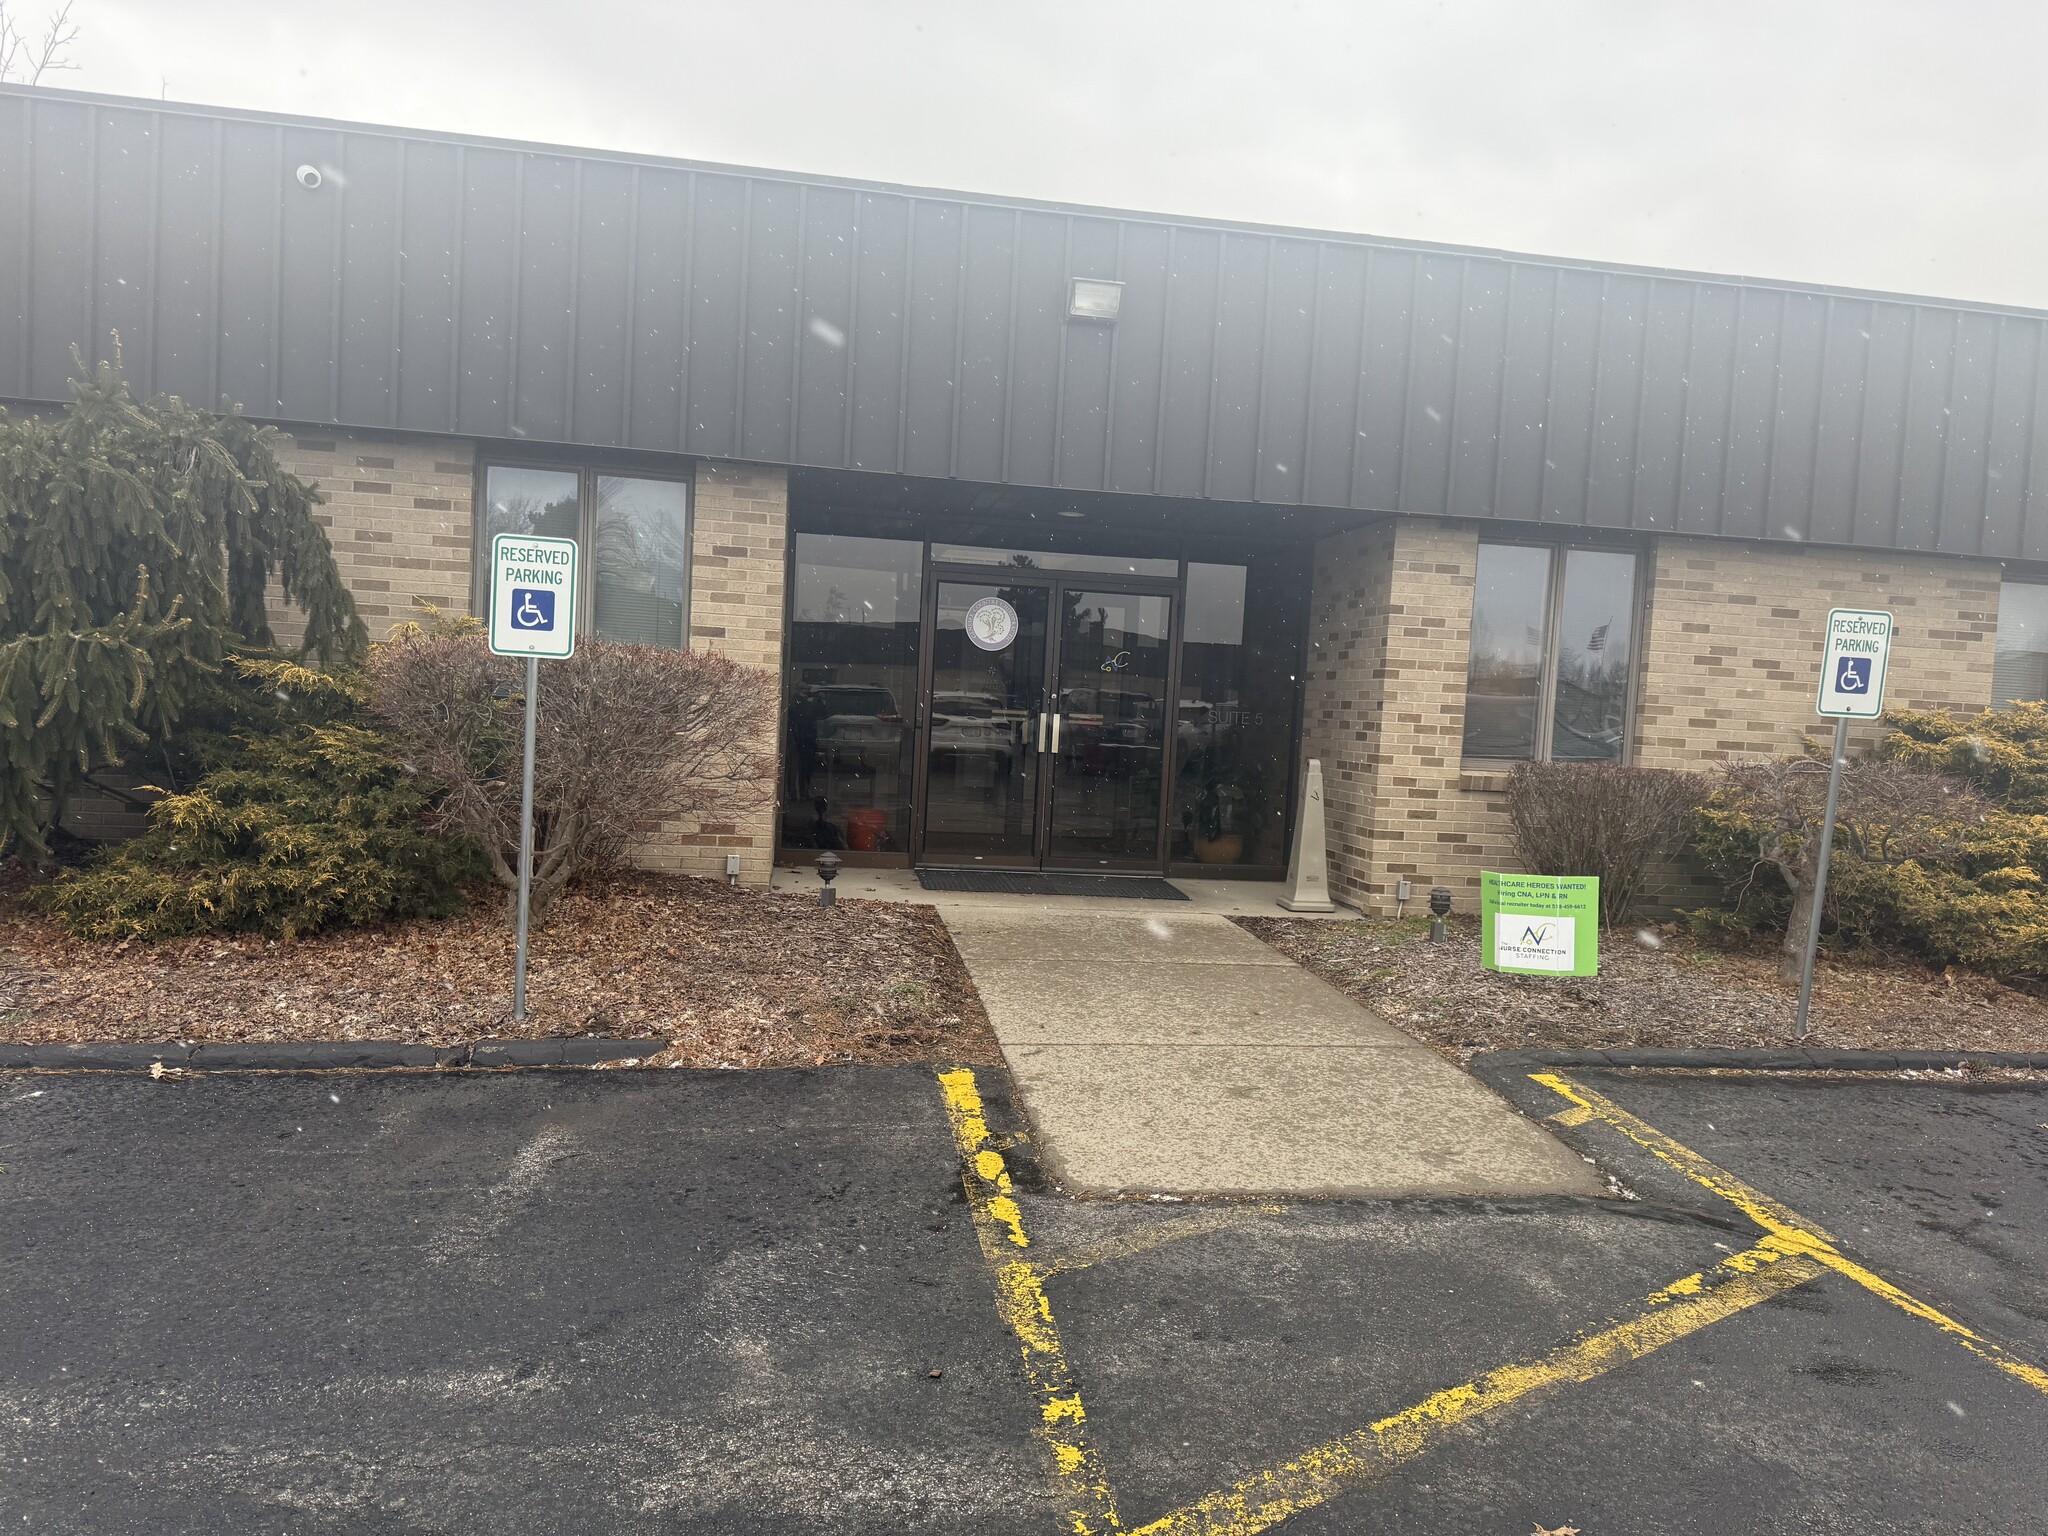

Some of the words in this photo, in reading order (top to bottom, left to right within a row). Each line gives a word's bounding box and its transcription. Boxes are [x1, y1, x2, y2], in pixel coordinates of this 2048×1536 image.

[500, 546, 570, 565] RESERVED
[505, 567, 563, 585] PARKING
[1833, 620, 1886, 635] RESERVED
[1835, 638, 1879, 653] PARKING
[1208, 710, 1250, 724] SUITE
[1255, 712, 1264, 725] 5
[1517, 891, 1534, 899] CNA,
[1522, 947, 1567, 955] CONNECTION
